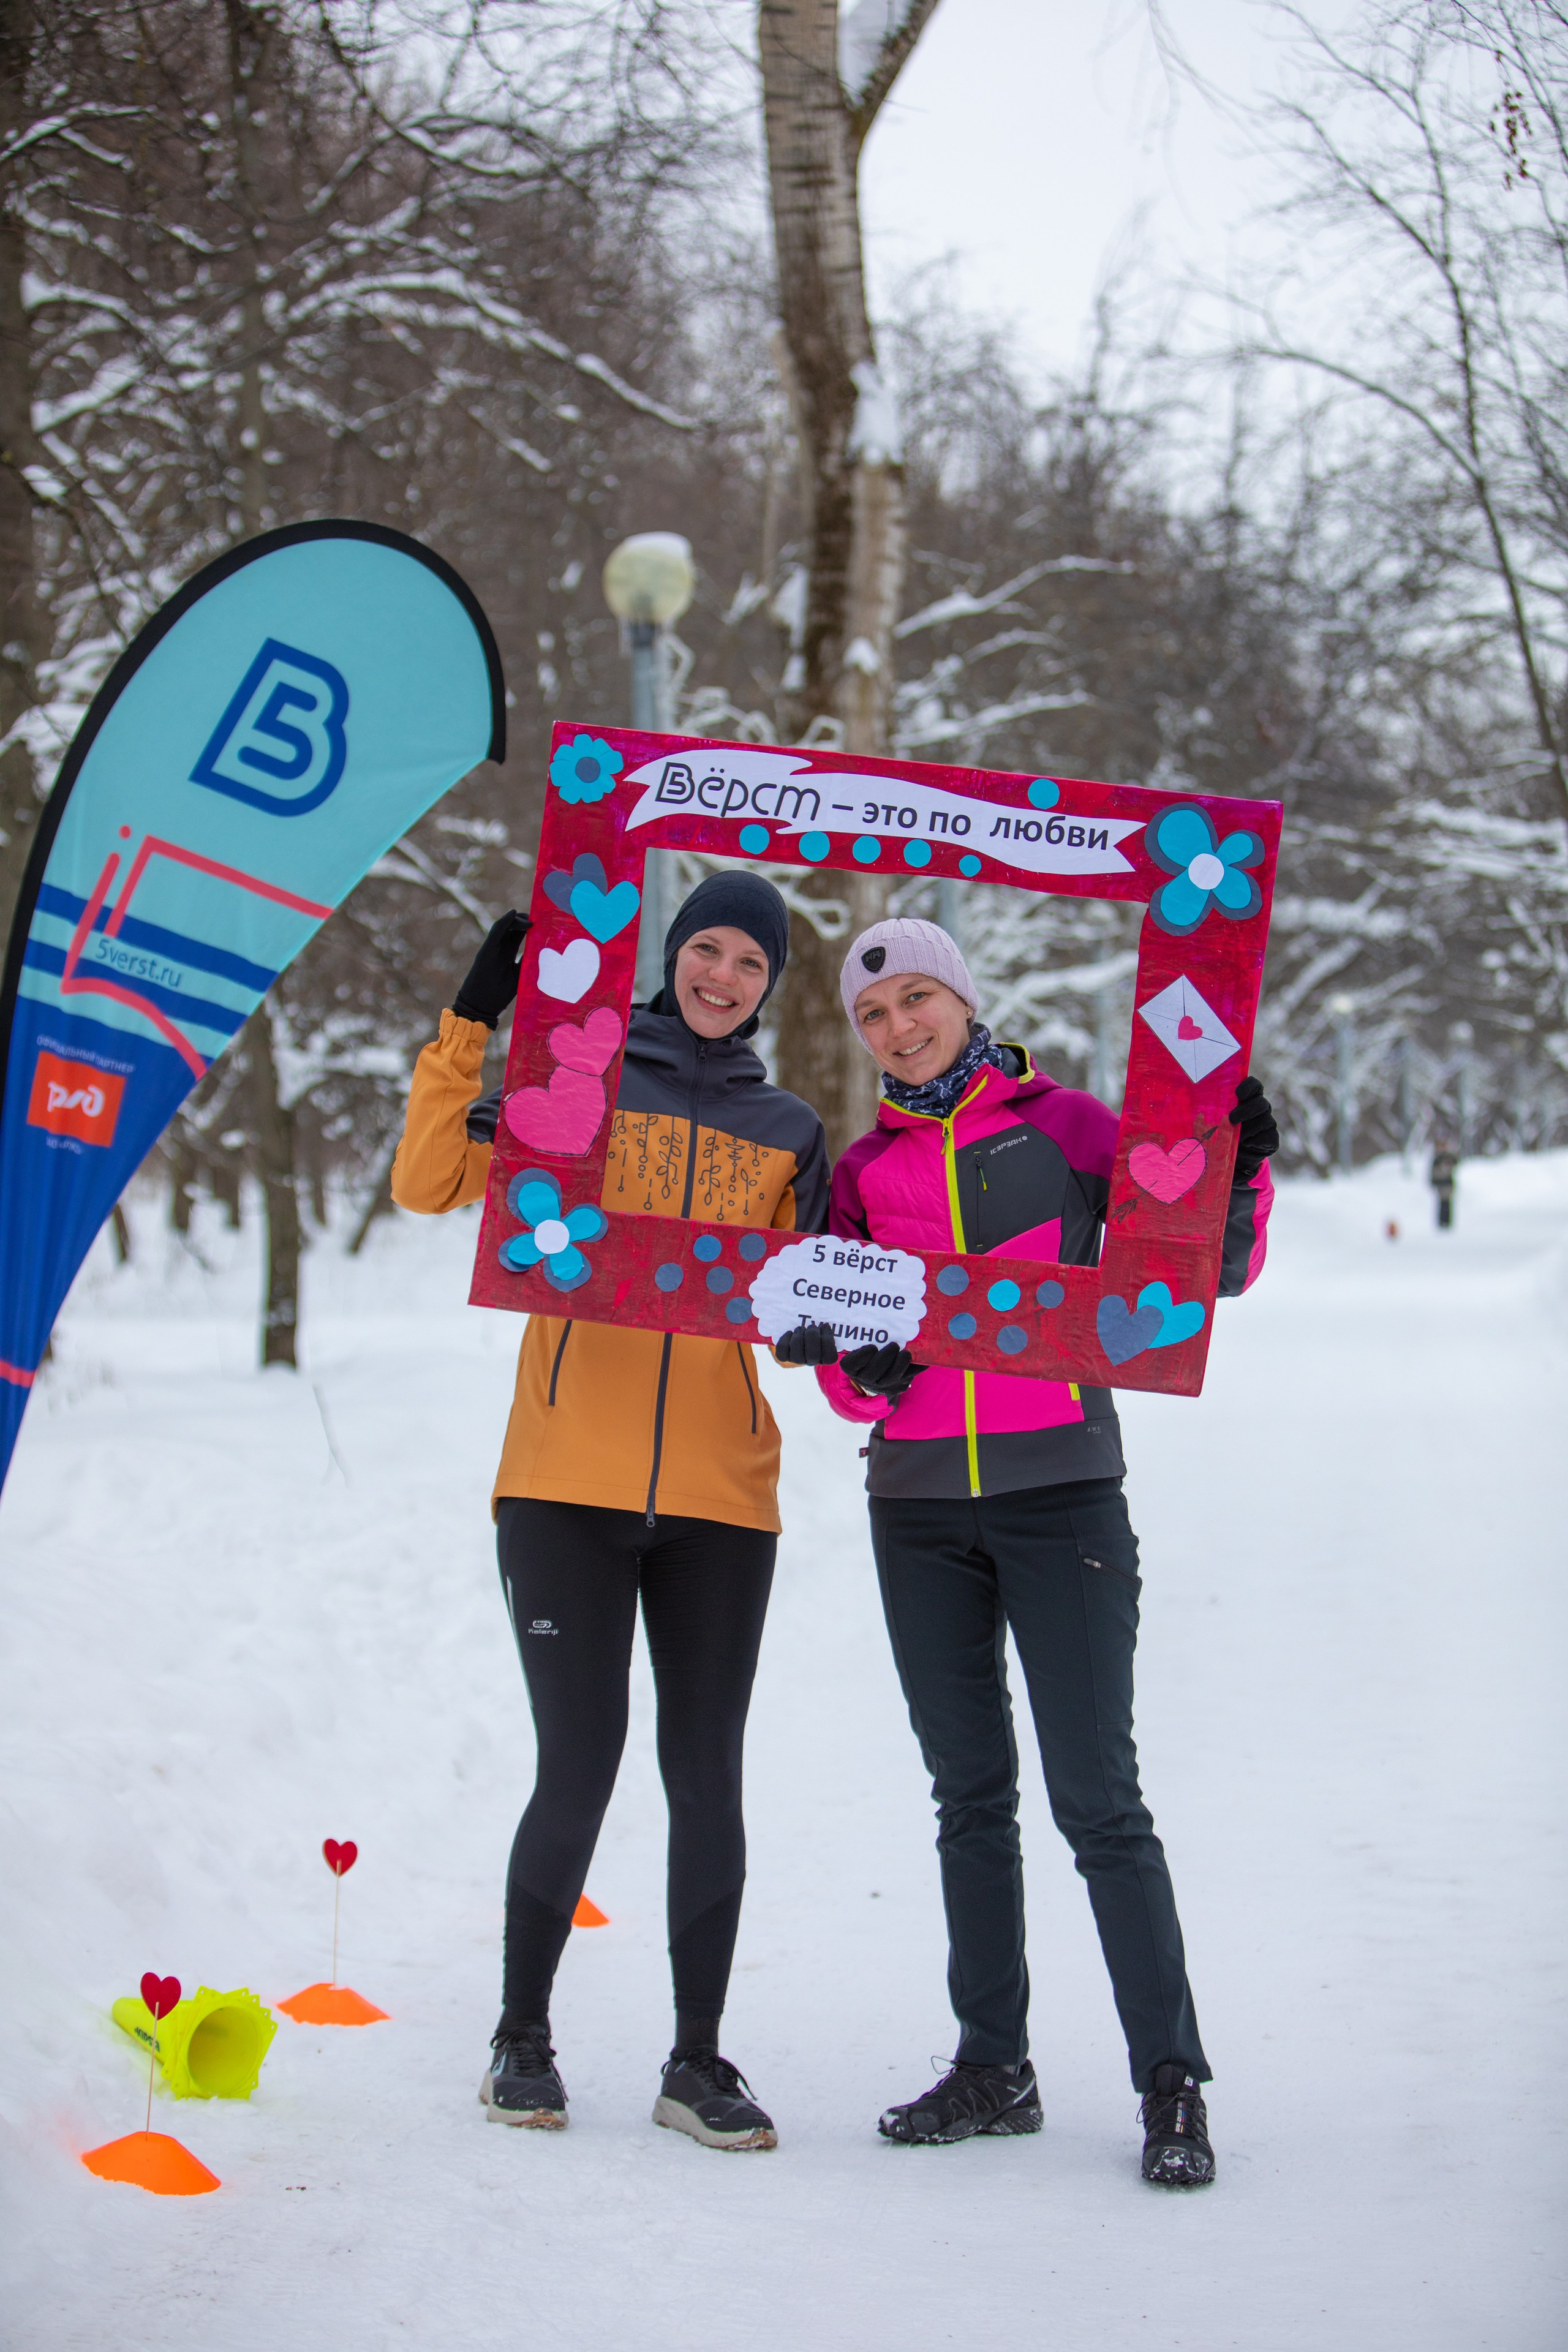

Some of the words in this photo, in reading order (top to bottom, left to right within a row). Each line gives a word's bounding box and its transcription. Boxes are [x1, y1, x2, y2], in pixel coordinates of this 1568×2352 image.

[862, 801, 919, 829] это
[929, 809, 971, 835] по
[990, 815, 1109, 851] любви
[95, 938, 182, 988] 5verst.ru
[990, 1137, 1022, 1155] ICEPEAK
[813, 1244, 826, 1263] 5
[833, 1248, 898, 1273] вёрст
[793, 1278, 906, 1310] Северное
